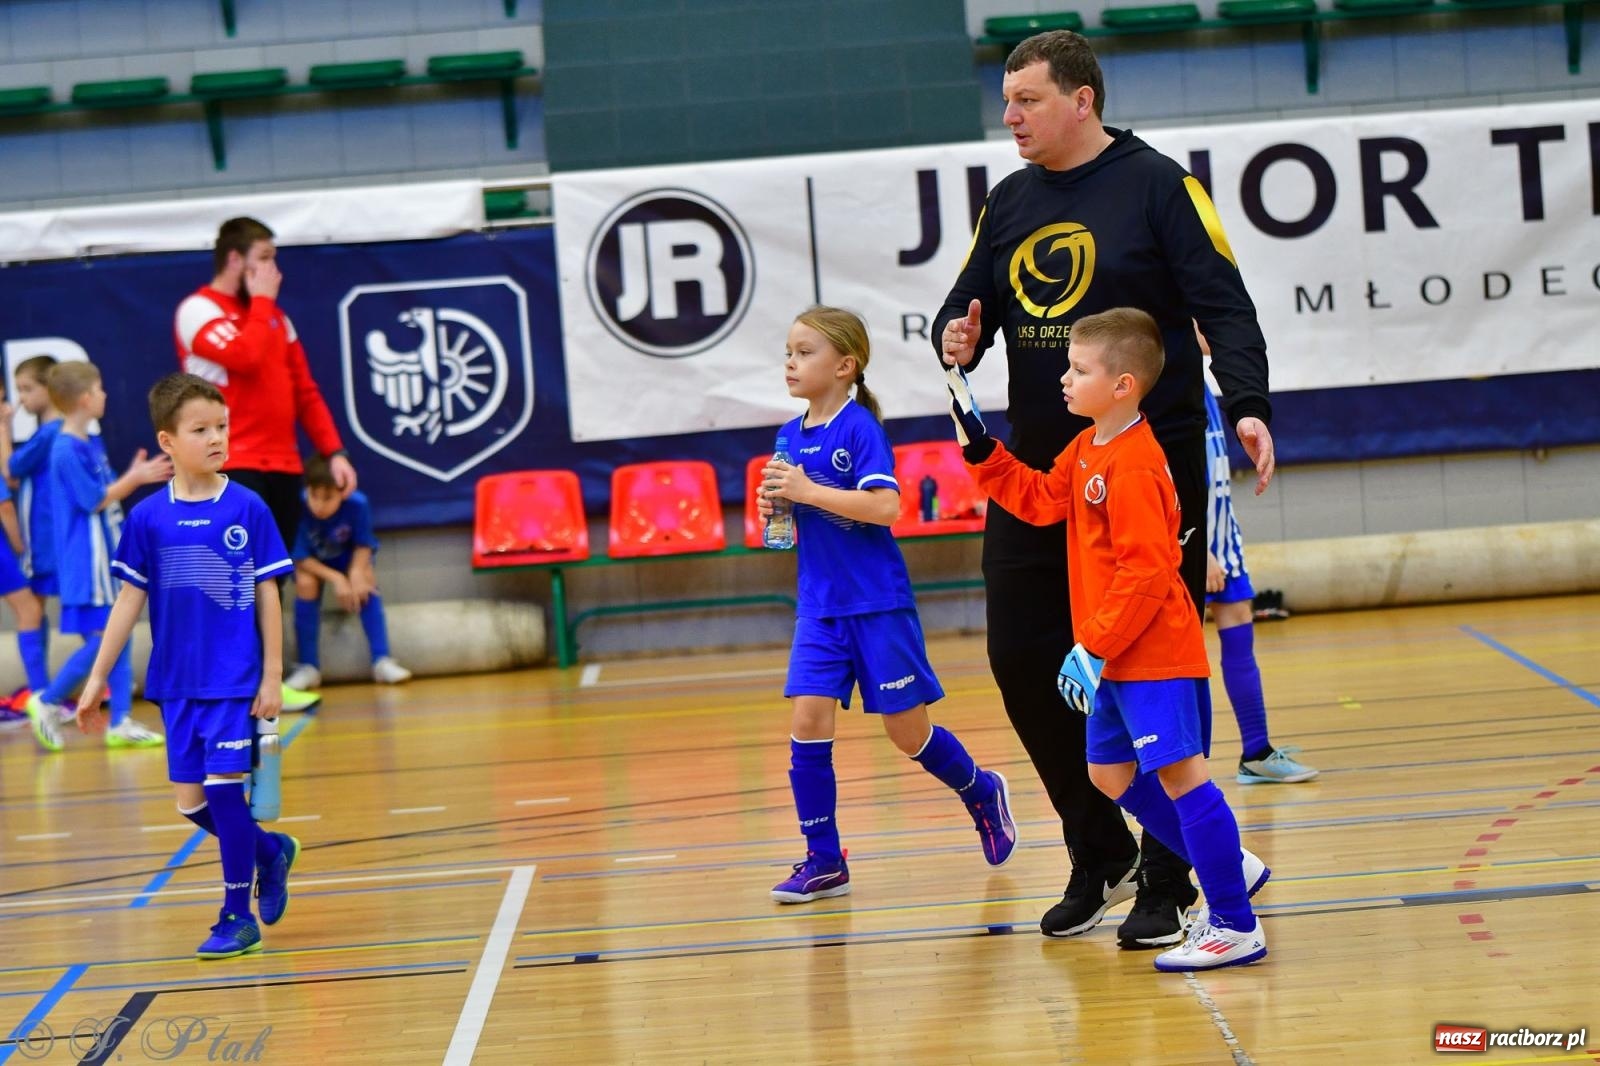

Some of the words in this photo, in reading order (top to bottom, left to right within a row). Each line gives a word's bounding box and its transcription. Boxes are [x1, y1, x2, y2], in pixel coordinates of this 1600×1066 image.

[616, 219, 728, 322] JR
[177, 519, 211, 527] regio
[879, 674, 916, 691] regio
[216, 738, 252, 750] regio
